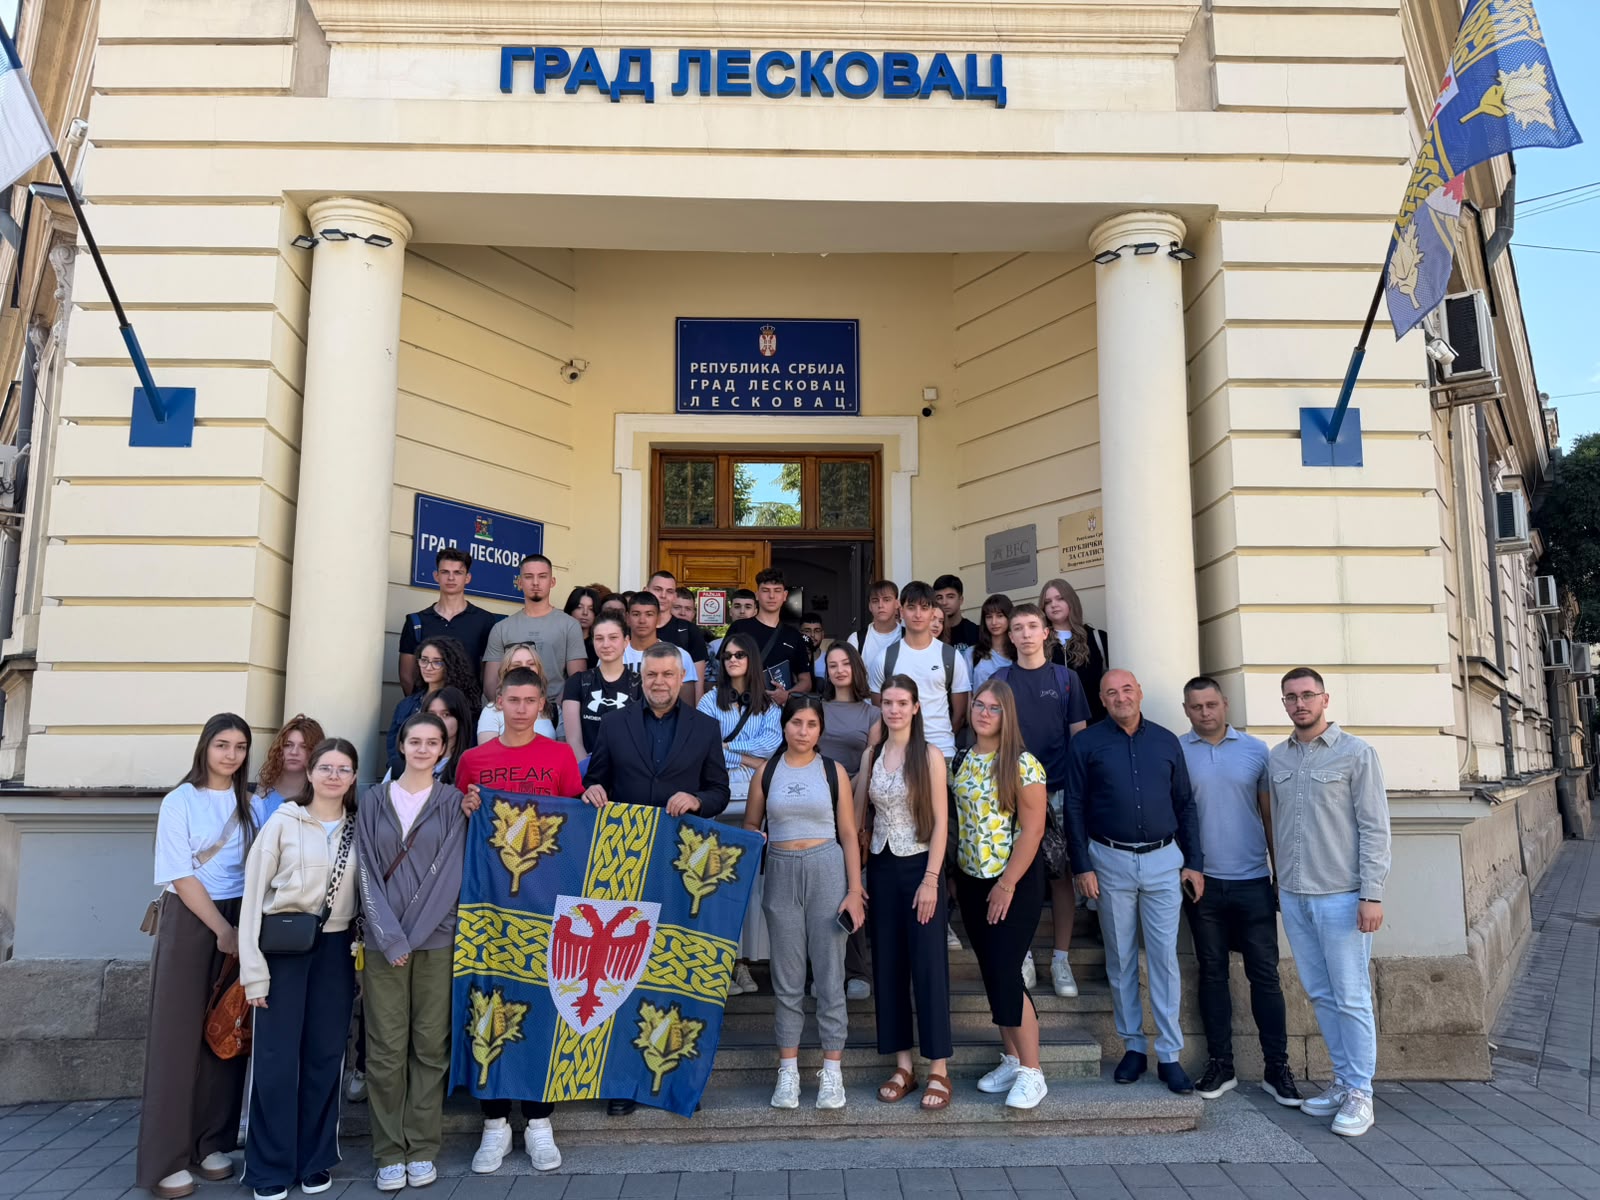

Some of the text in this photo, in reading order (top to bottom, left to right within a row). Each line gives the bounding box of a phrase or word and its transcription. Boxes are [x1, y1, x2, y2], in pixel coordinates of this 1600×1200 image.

[500, 46, 1007, 109] ГРАД ЛЕСКОВАЦ
[690, 362, 845, 375] РЕПУБЛИКА СРБИЈА
[690, 379, 845, 393] ГРАД ЛЕСКОВАЦ
[480, 766, 554, 785] BREAK
